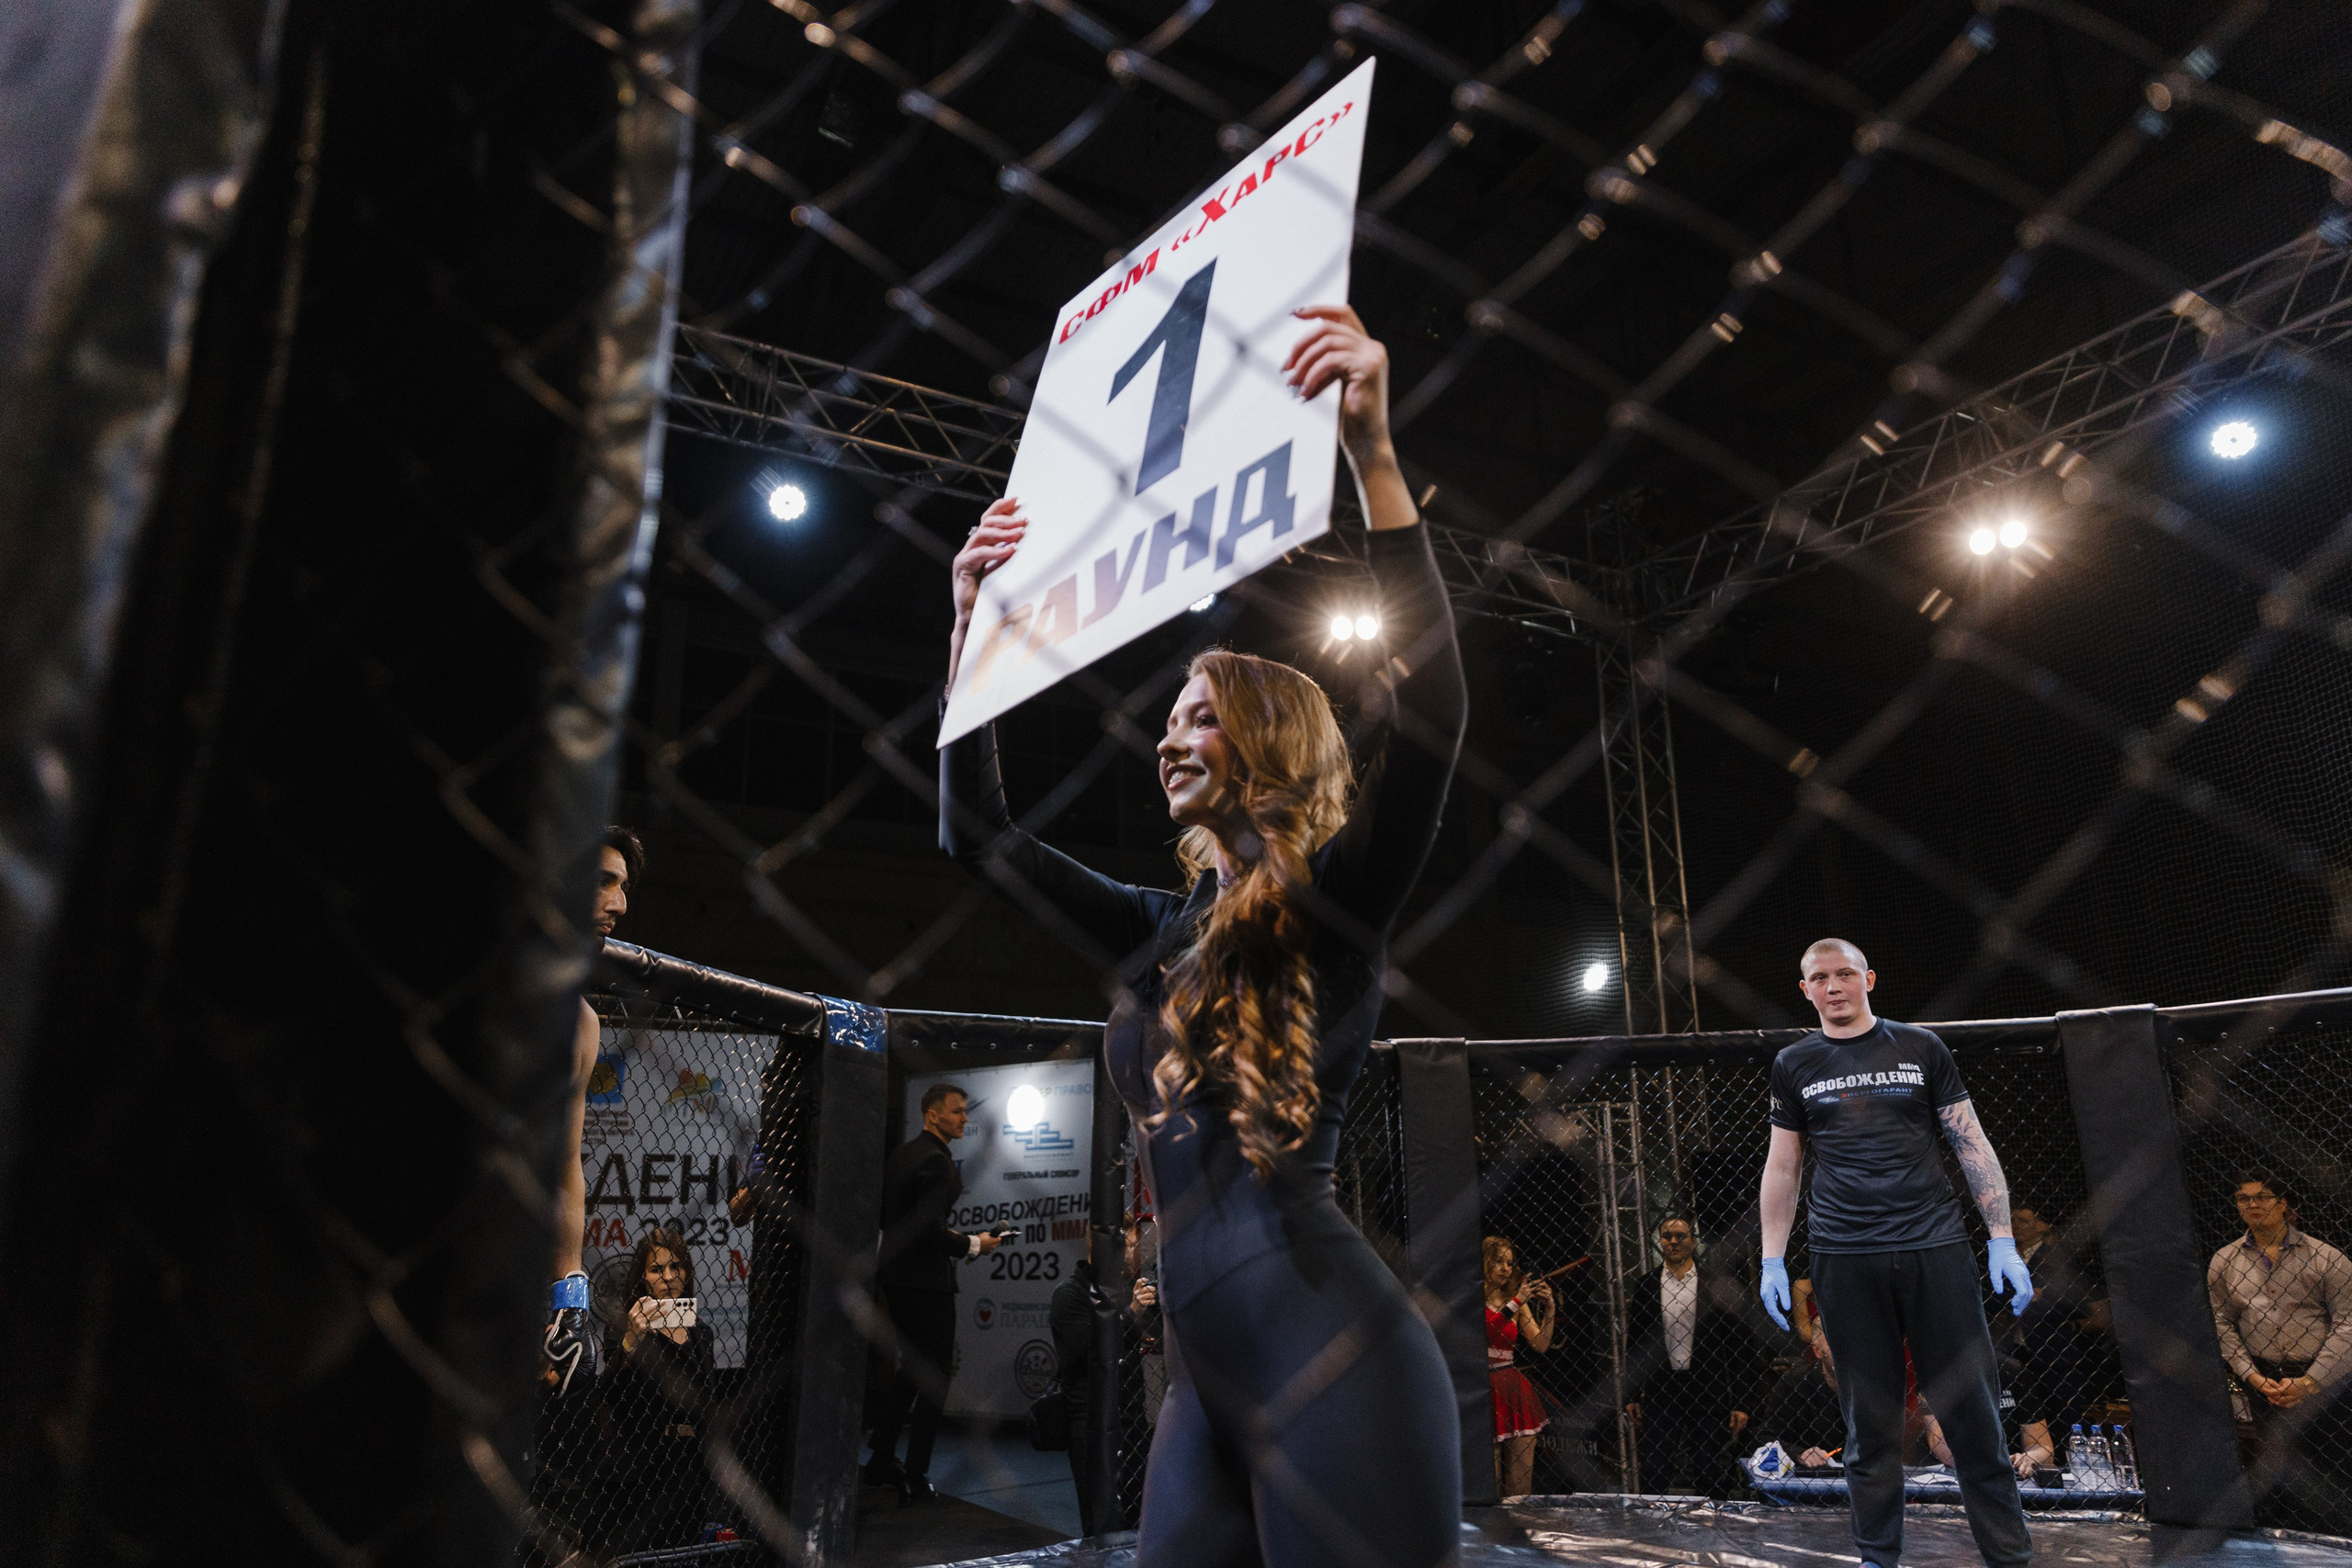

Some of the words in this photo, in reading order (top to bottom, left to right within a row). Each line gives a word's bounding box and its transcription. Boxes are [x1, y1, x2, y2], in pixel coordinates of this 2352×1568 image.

[1058, 246, 1161, 345] СФМ
[1172, 101, 1354, 254] «ХАРС»
[1107, 255, 1219, 496] 1
[969, 437, 1297, 695] РАУНД
[1801, 1070, 1926, 1100] ОСВОБОЖДЕНИЕ
[990, 1251, 1060, 1280] 2023
[1025, 1224, 1046, 1244] ПО
